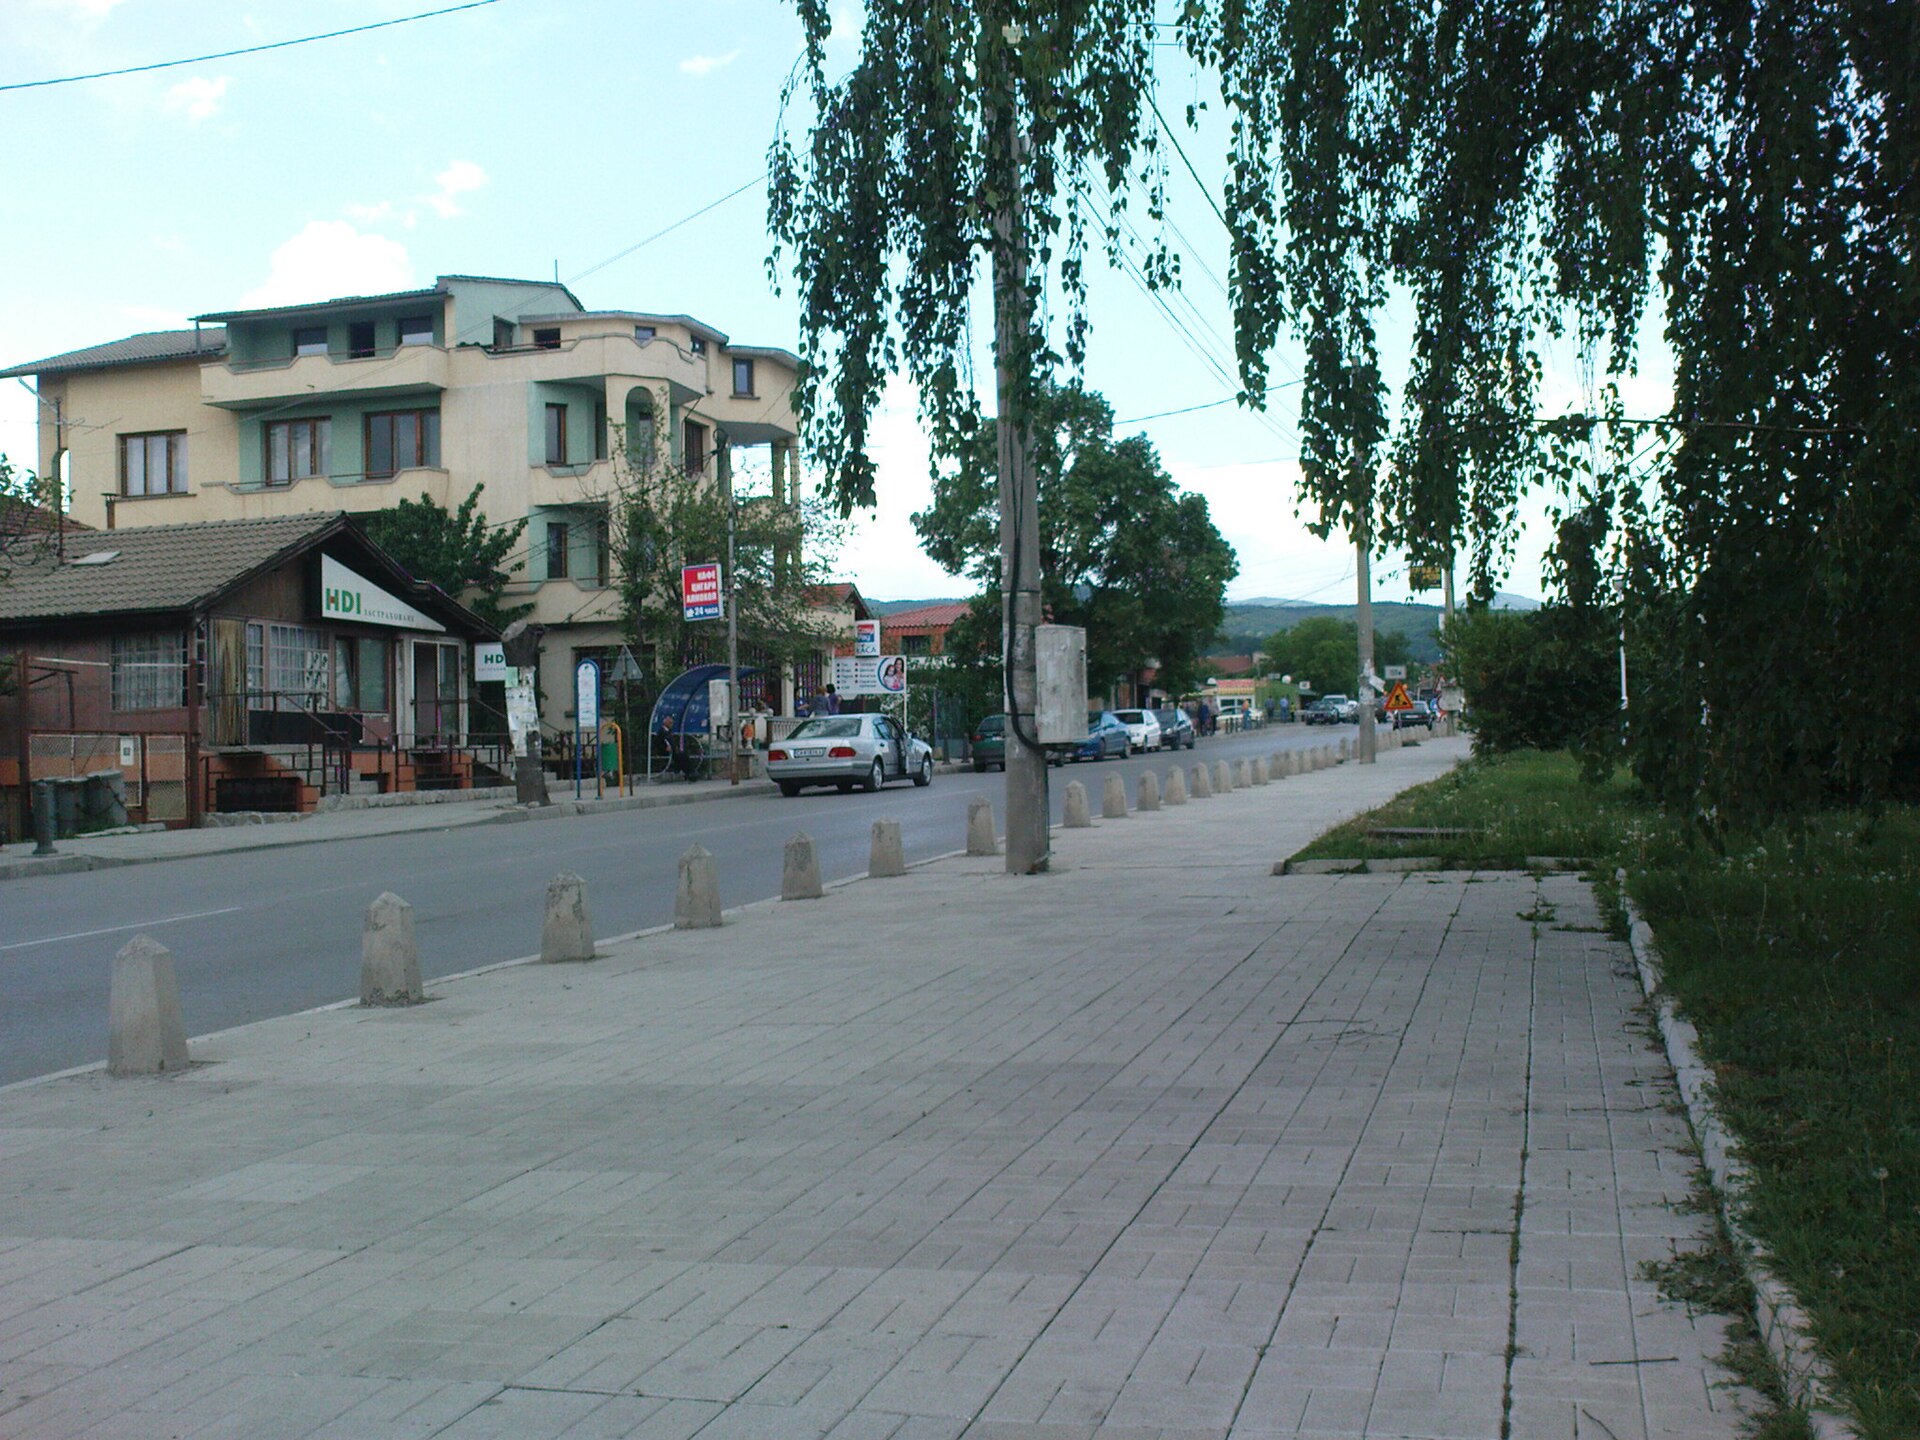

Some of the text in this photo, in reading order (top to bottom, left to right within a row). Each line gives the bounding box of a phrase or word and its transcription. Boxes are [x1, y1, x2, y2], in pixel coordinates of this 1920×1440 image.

[691, 581, 717, 592] ЦИГАРИ
[326, 588, 361, 615] HDI
[484, 654, 505, 664] HD
